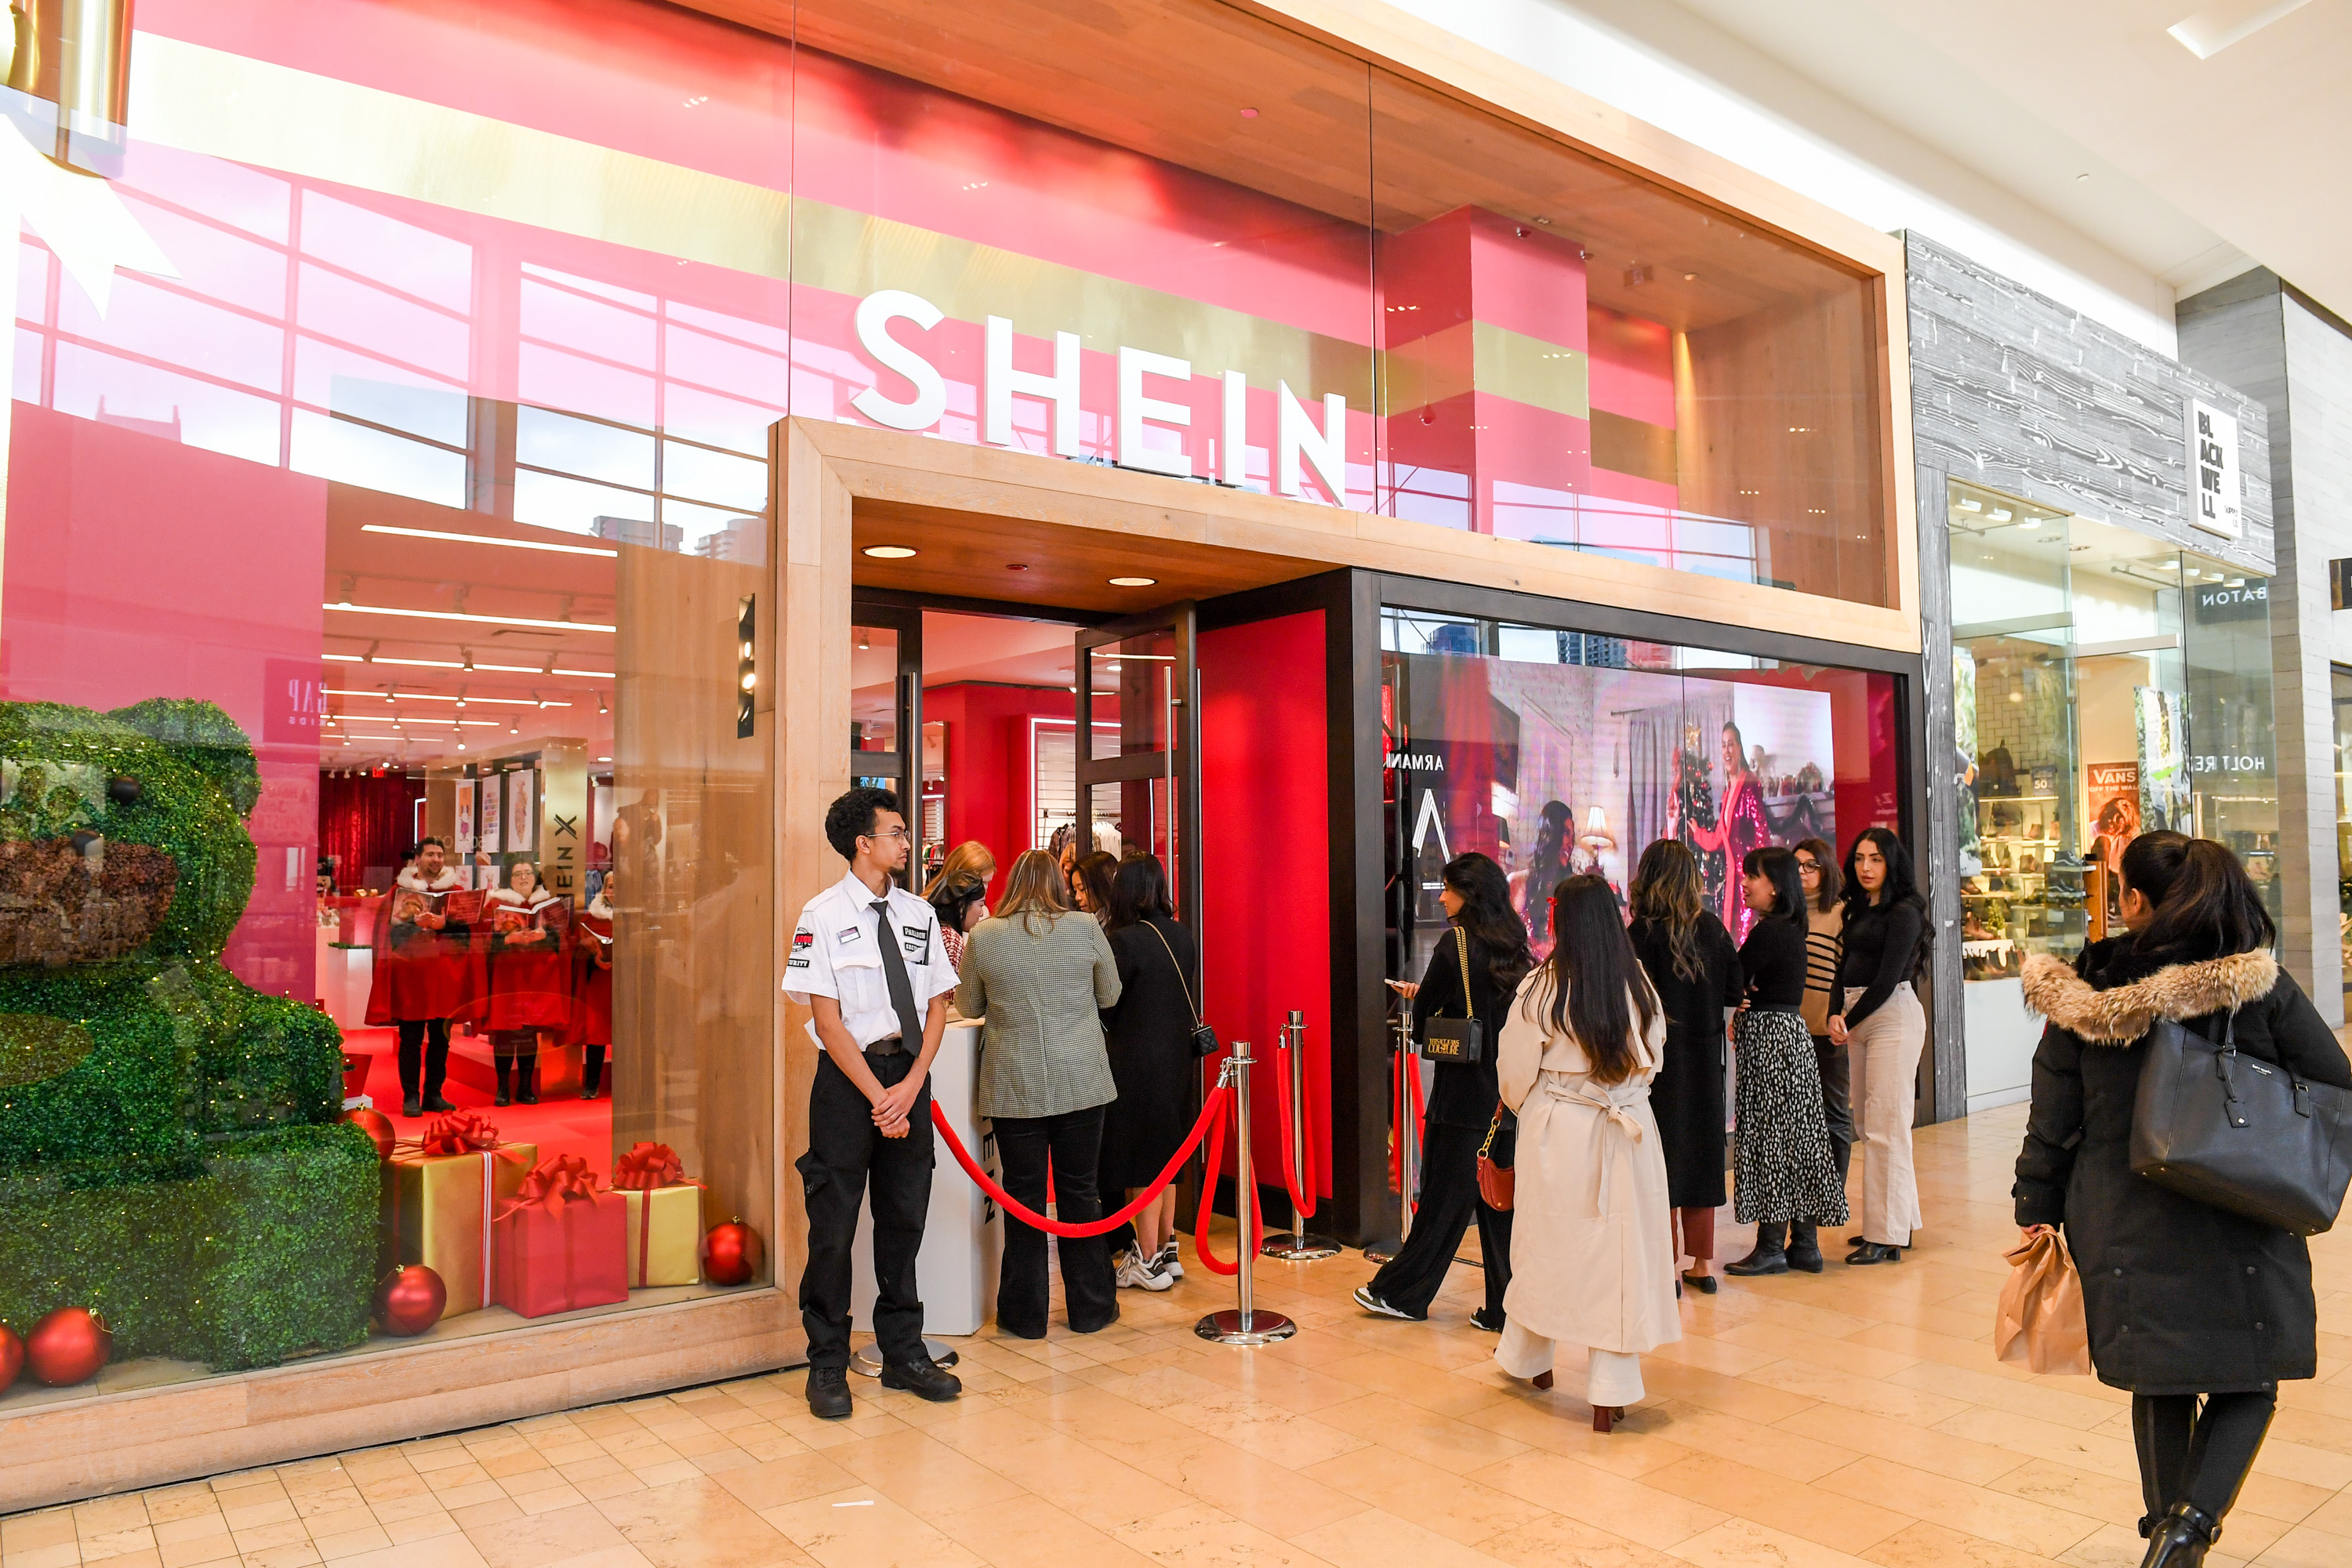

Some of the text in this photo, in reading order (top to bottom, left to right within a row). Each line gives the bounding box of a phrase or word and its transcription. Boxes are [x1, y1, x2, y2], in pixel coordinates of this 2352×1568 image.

[851, 289, 1346, 508] SHEIN
[2198, 410, 2213, 439] BL
[2200, 438, 2223, 470] ACK
[2200, 464, 2220, 495] WE
[2201, 492, 2216, 519] LL
[2093, 768, 2137, 785] VANS
[557, 847, 574, 898] EIN
[795, 935, 812, 943] AGON
